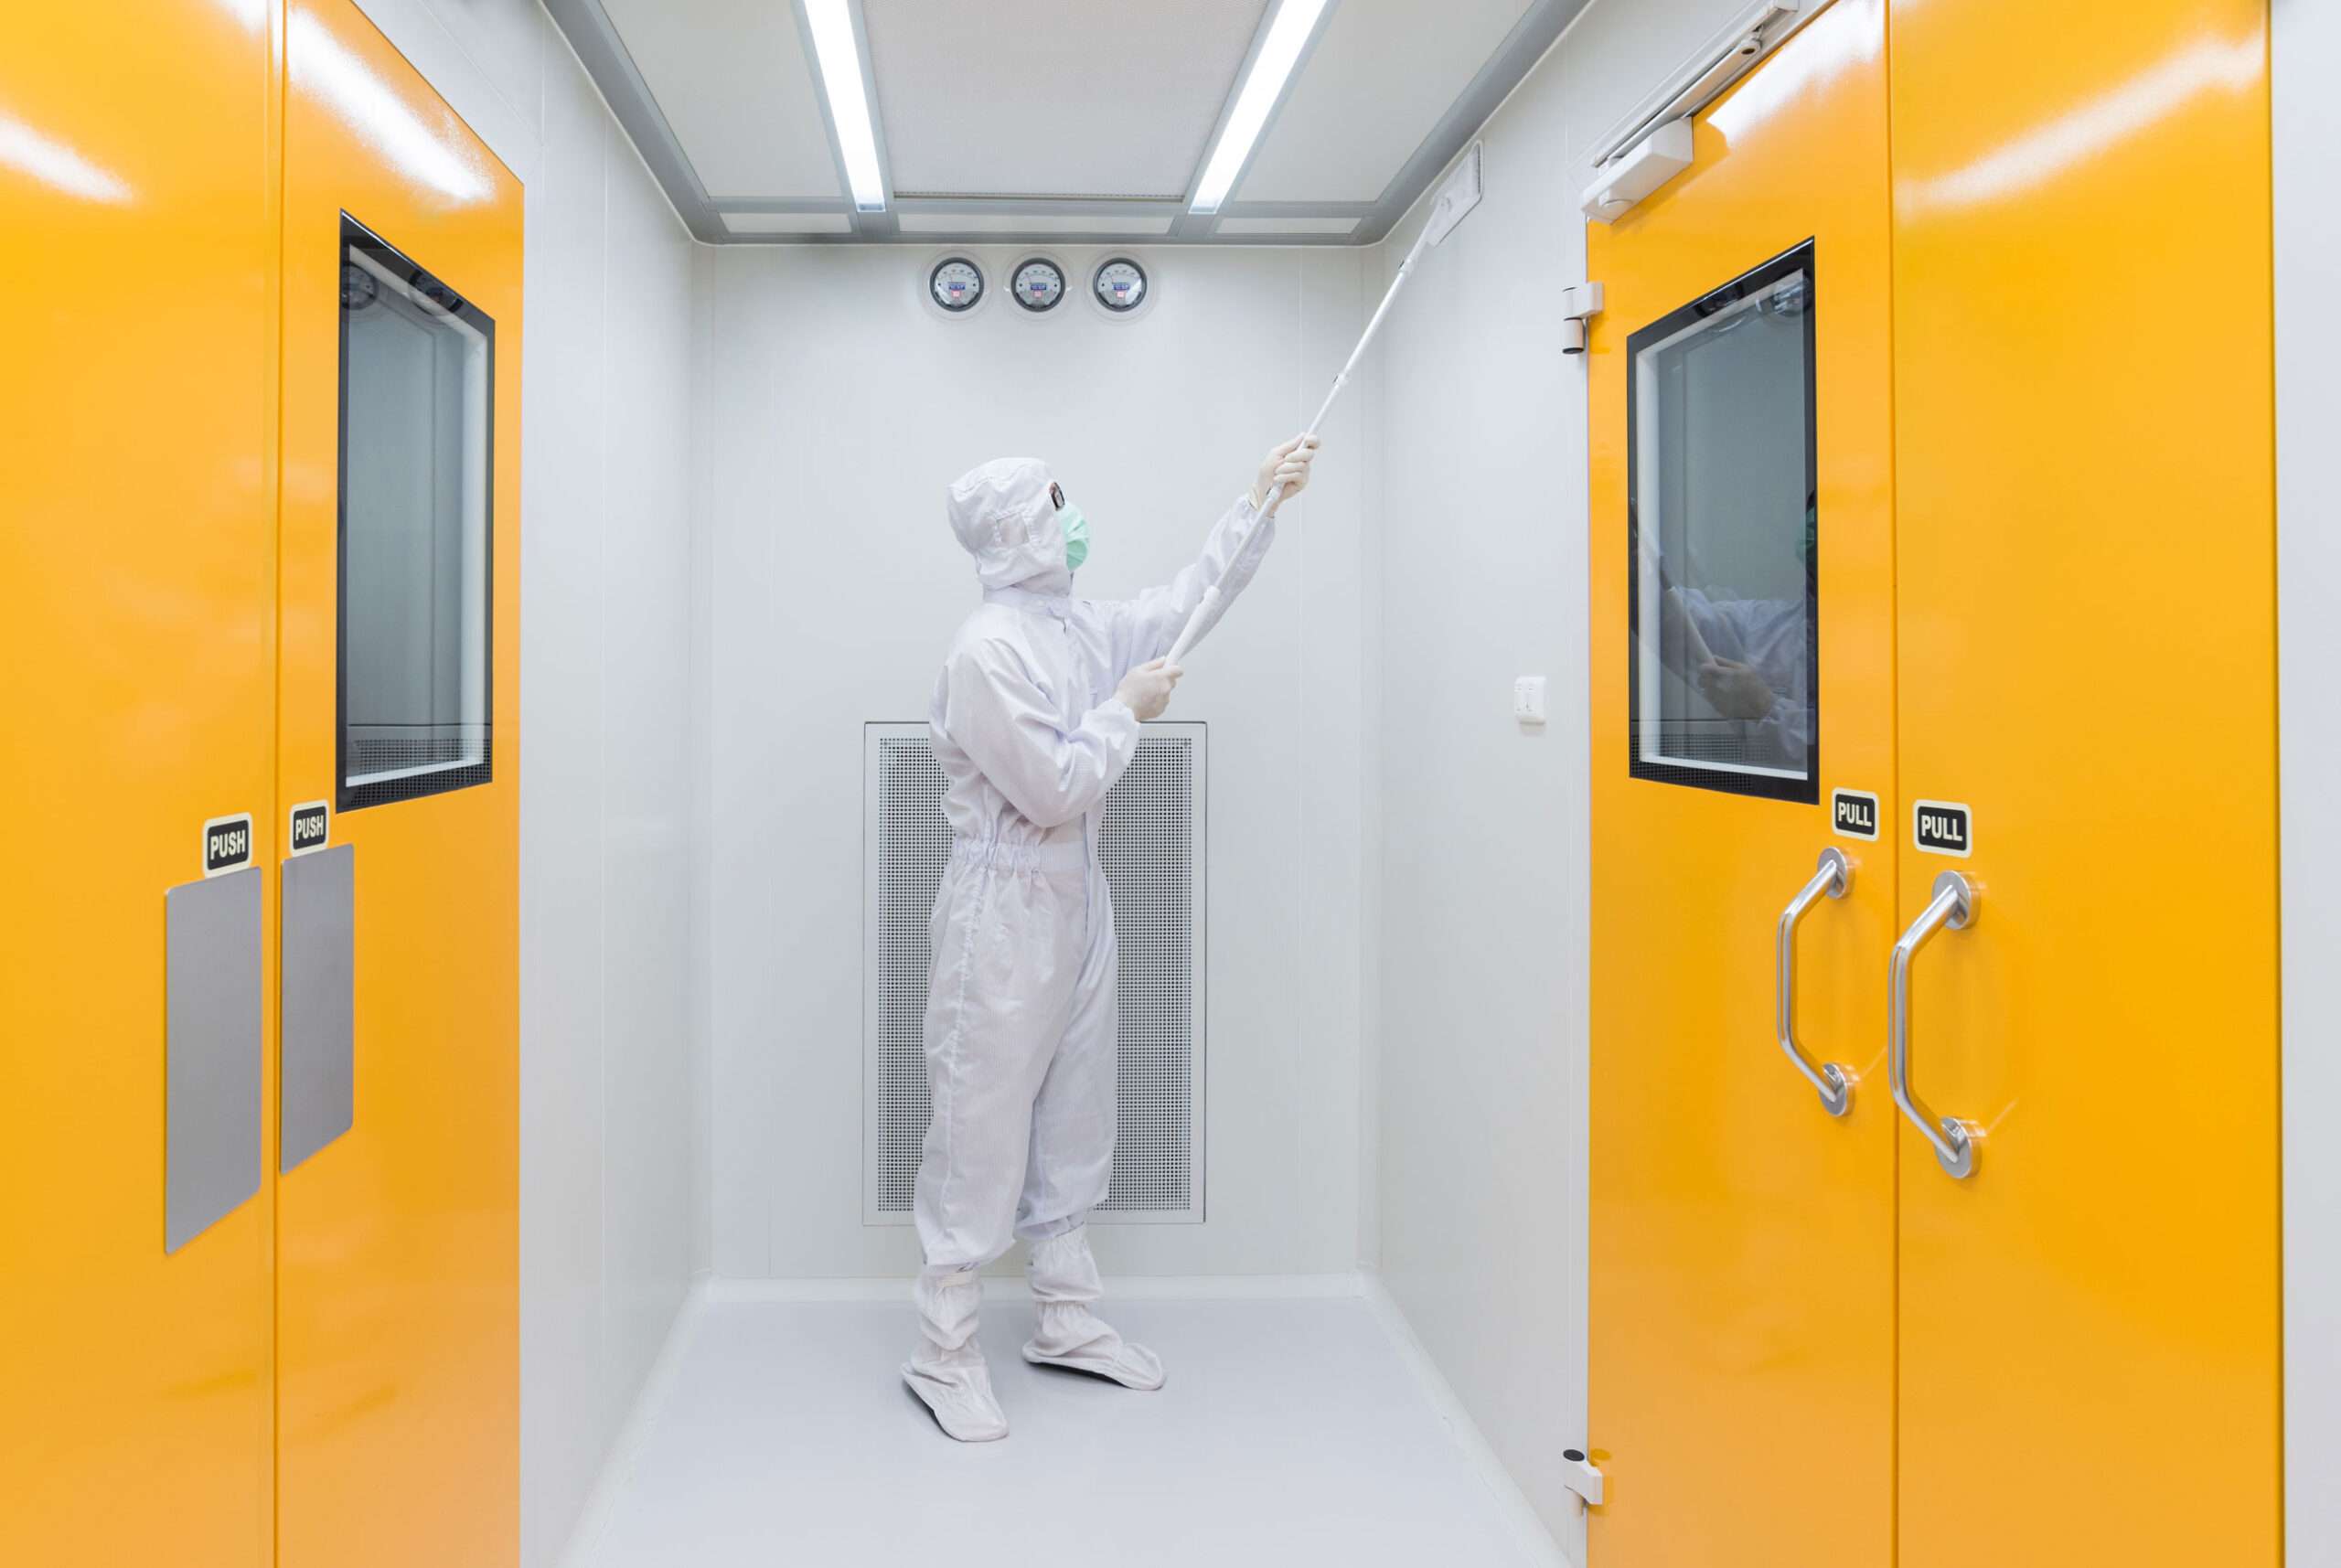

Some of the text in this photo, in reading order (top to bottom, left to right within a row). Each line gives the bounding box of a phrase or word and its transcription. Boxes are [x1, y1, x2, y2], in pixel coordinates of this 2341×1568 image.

[1838, 802, 1872, 827] PULL
[295, 815, 324, 841] PUSH
[1921, 815, 1962, 841] PULL
[210, 829, 245, 859] PUSH
